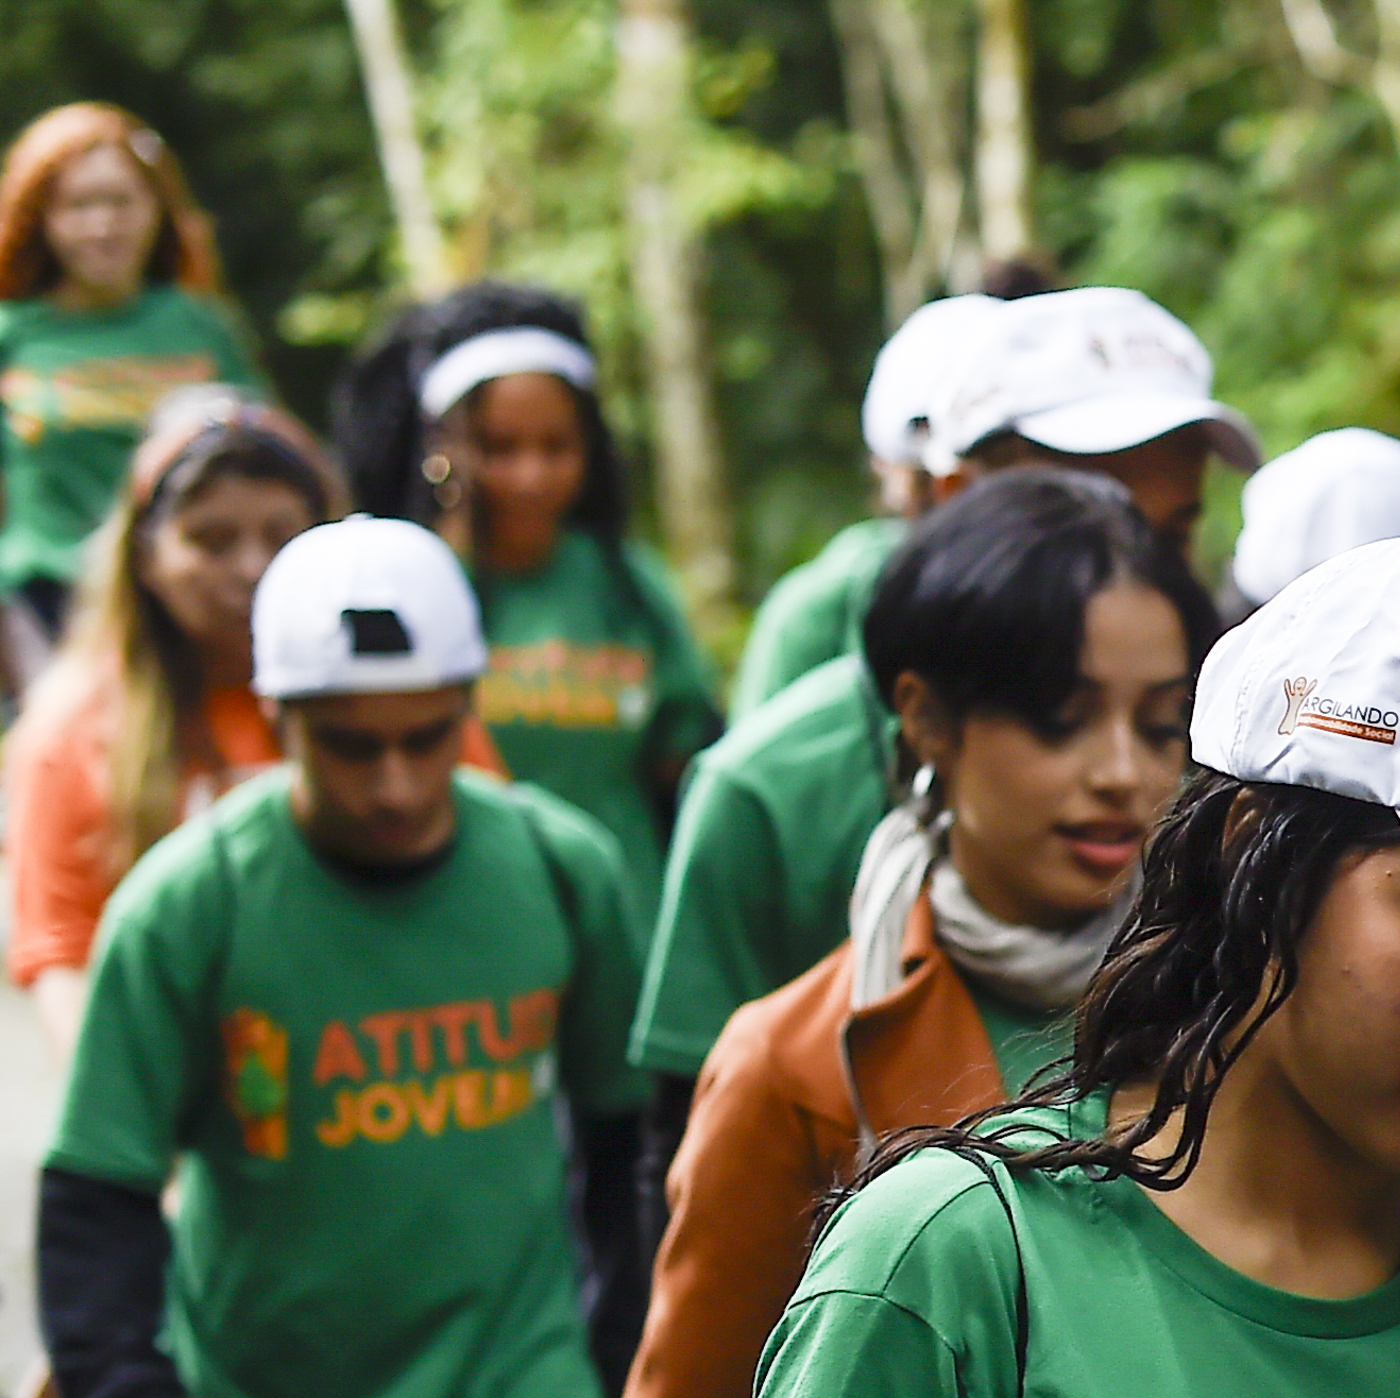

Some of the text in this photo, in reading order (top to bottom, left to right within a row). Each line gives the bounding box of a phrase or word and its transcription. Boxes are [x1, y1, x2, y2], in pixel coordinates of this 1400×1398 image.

[1302, 697, 1398, 727] ARGILANDO
[1365, 727, 1394, 740] Social
[312, 988, 560, 1086] ATITU
